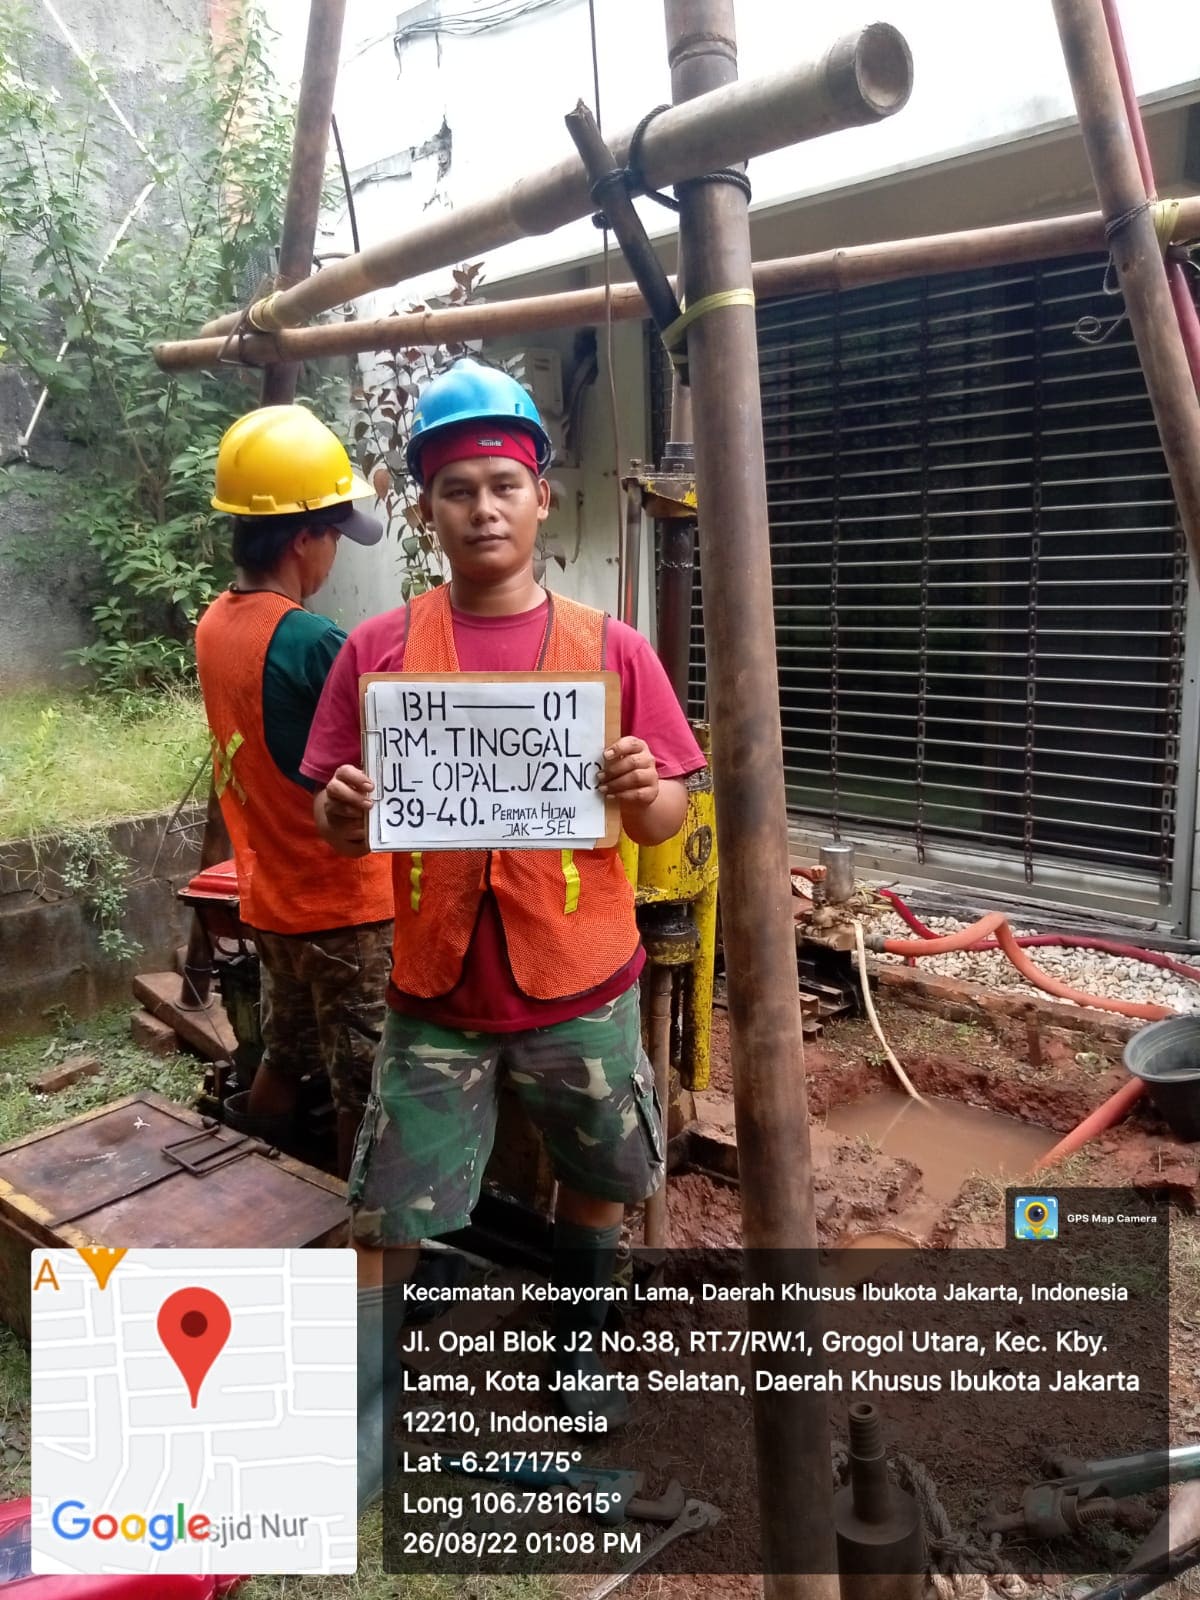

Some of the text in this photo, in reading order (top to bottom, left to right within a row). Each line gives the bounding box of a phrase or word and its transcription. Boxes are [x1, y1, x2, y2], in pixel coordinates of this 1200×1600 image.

[402, 690, 447, 722] BH
[542, 689, 577, 722] 01
[383, 727, 582, 758] RM. TINGGAL
[386, 797, 485, 829] 39-40.
[492, 801, 576, 821] PERMATA HIJAU
